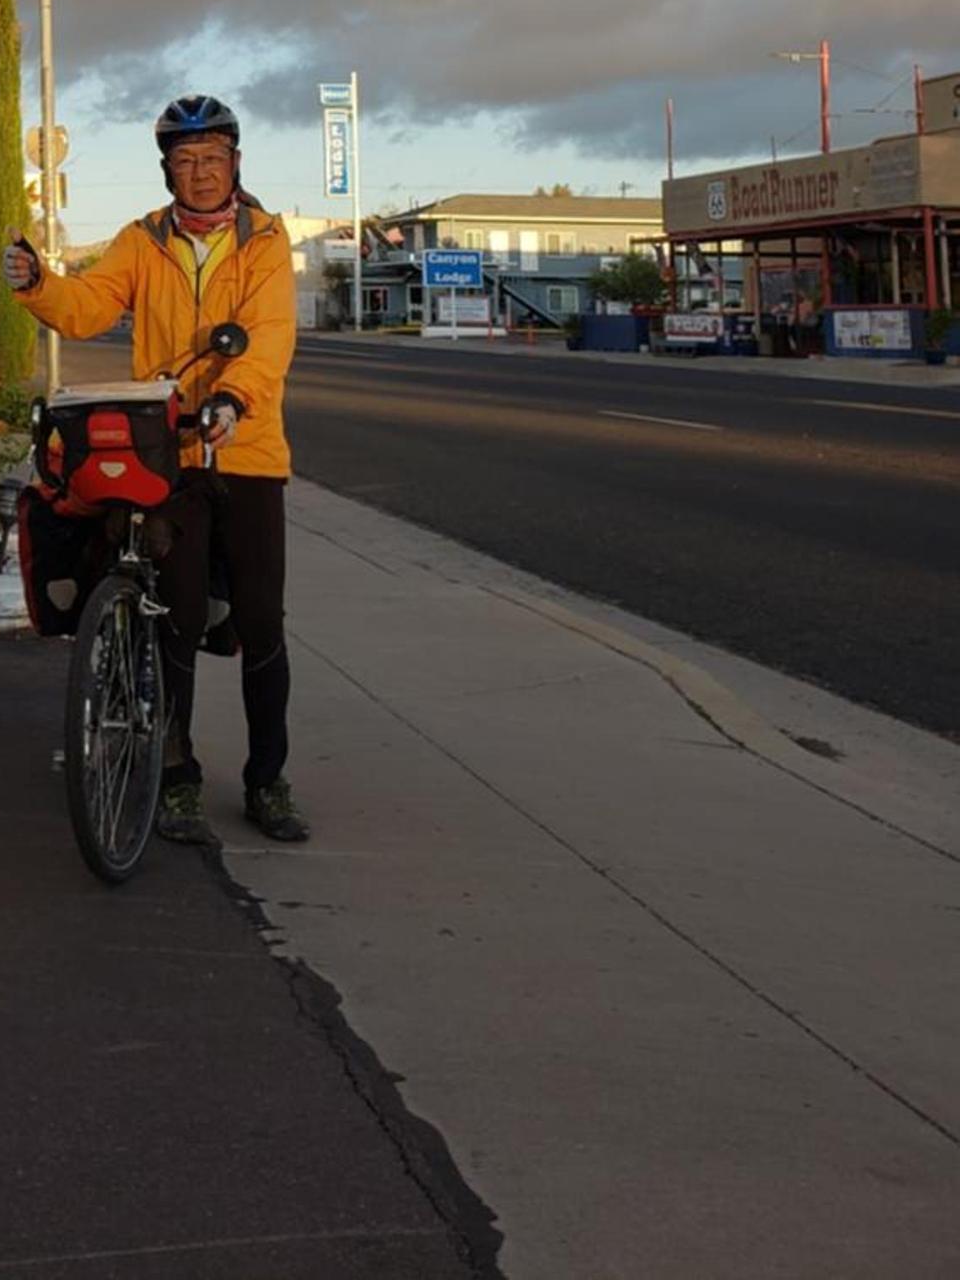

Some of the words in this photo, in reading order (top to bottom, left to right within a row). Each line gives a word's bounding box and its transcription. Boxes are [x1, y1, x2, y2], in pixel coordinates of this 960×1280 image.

[730, 169, 840, 220] RoadRunner
[427, 252, 478, 266] Canyon
[434, 272, 472, 285] Lodge
